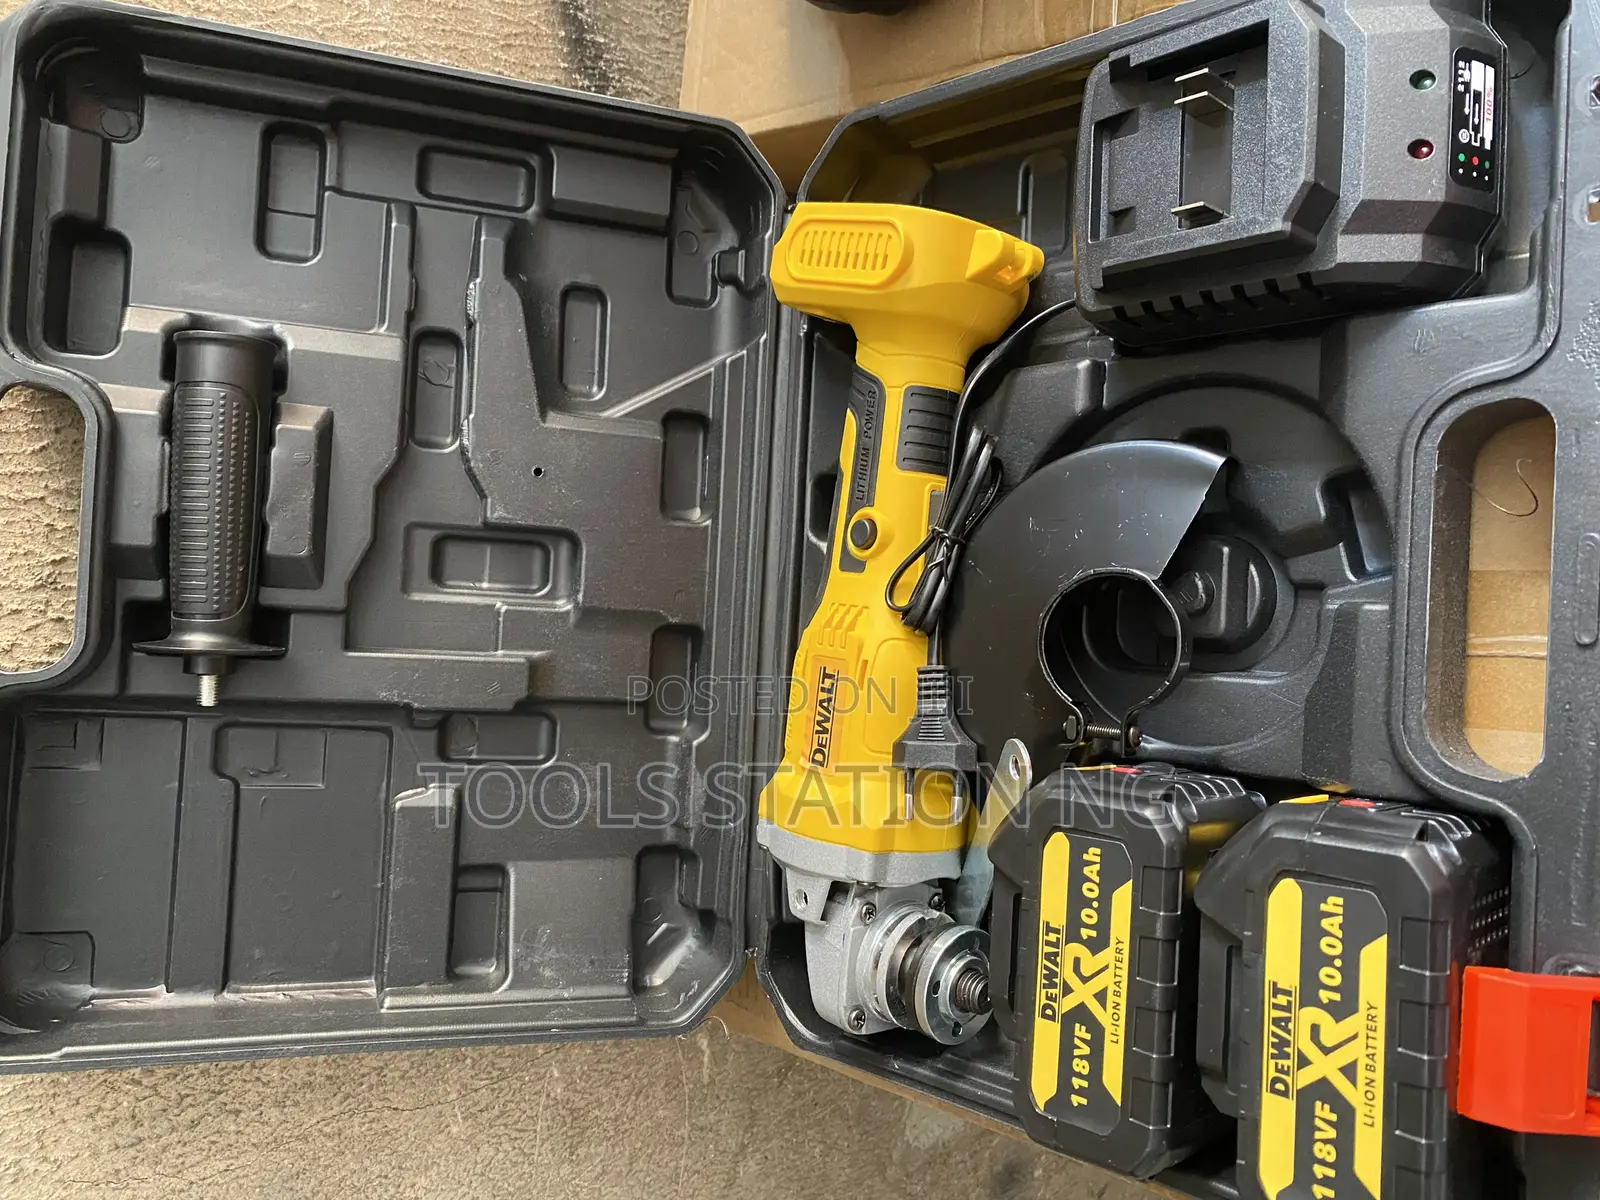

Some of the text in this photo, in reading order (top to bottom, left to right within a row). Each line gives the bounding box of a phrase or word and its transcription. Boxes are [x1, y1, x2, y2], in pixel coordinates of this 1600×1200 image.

[1485, 87, 1493, 122] 100%
[855, 390, 877, 501] LITHIUM POWER
[1080, 846, 1102, 940] 10.0Ah
[1110, 936, 1125, 1045] LI-ION BATTERY
[1318, 895, 1344, 1004] 10.0Ah
[1070, 1022, 1092, 1107] 118VF
[1363, 1001, 1380, 1128] LI-ION BATTERY
[1311, 1100, 1339, 1199] 118VF
